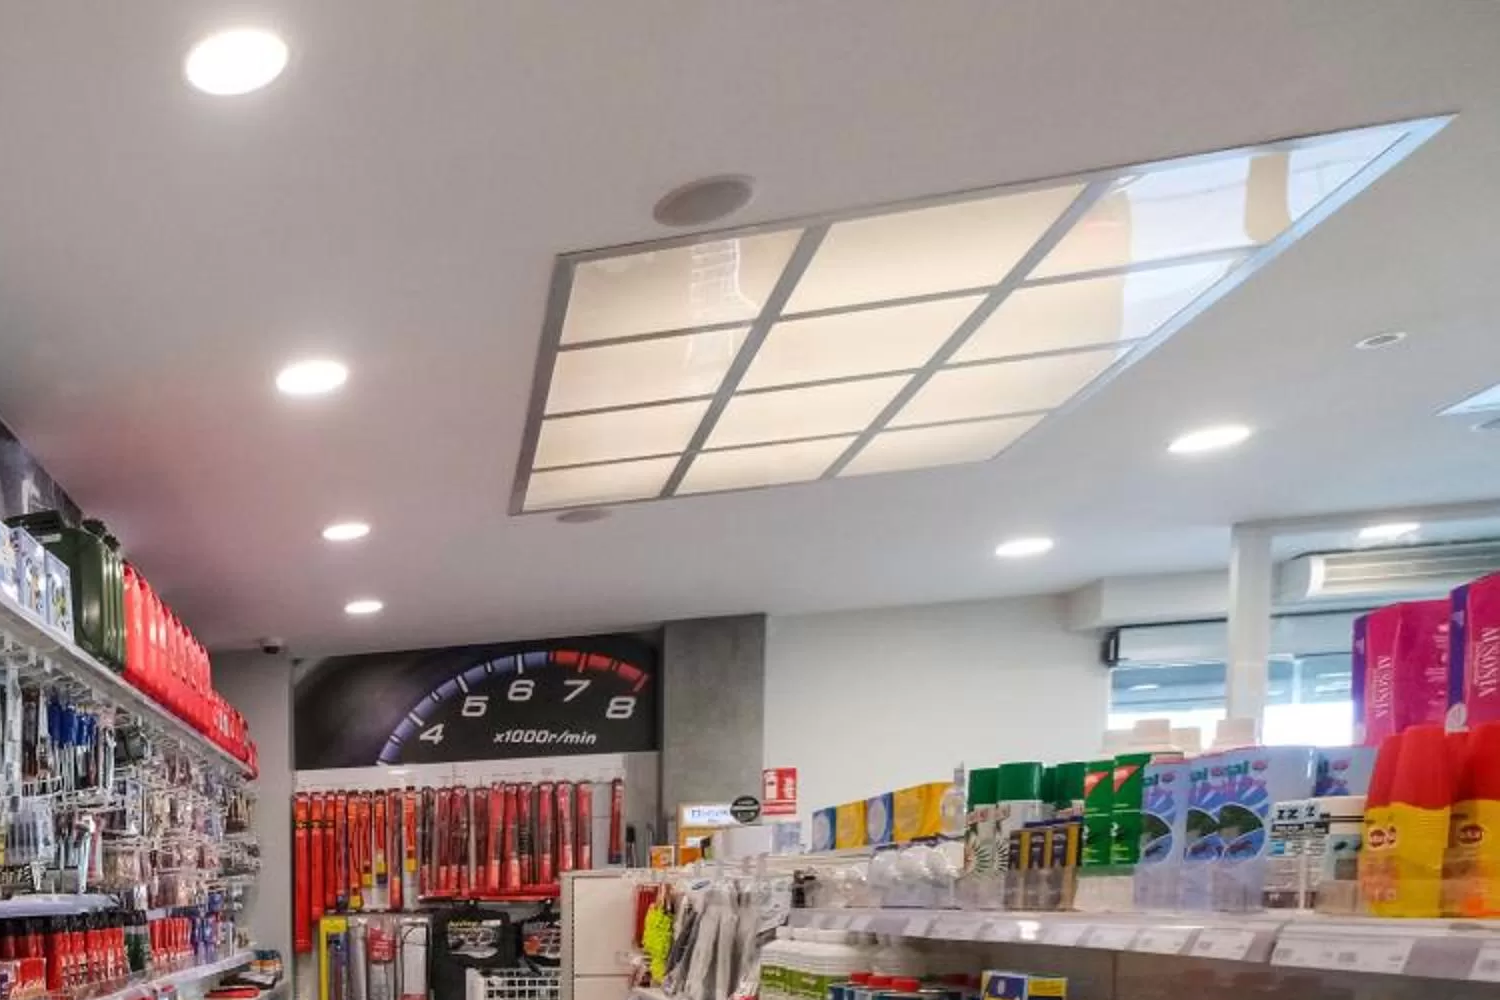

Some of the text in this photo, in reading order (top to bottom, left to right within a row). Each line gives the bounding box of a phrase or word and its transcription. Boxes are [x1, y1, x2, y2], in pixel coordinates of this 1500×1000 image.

[507, 679, 536, 702] 6
[563, 679, 592, 703] 7
[461, 695, 490, 718] 5
[605, 696, 637, 720] 8
[419, 722, 446, 746] 4
[492, 728, 599, 746] x1000r/min
